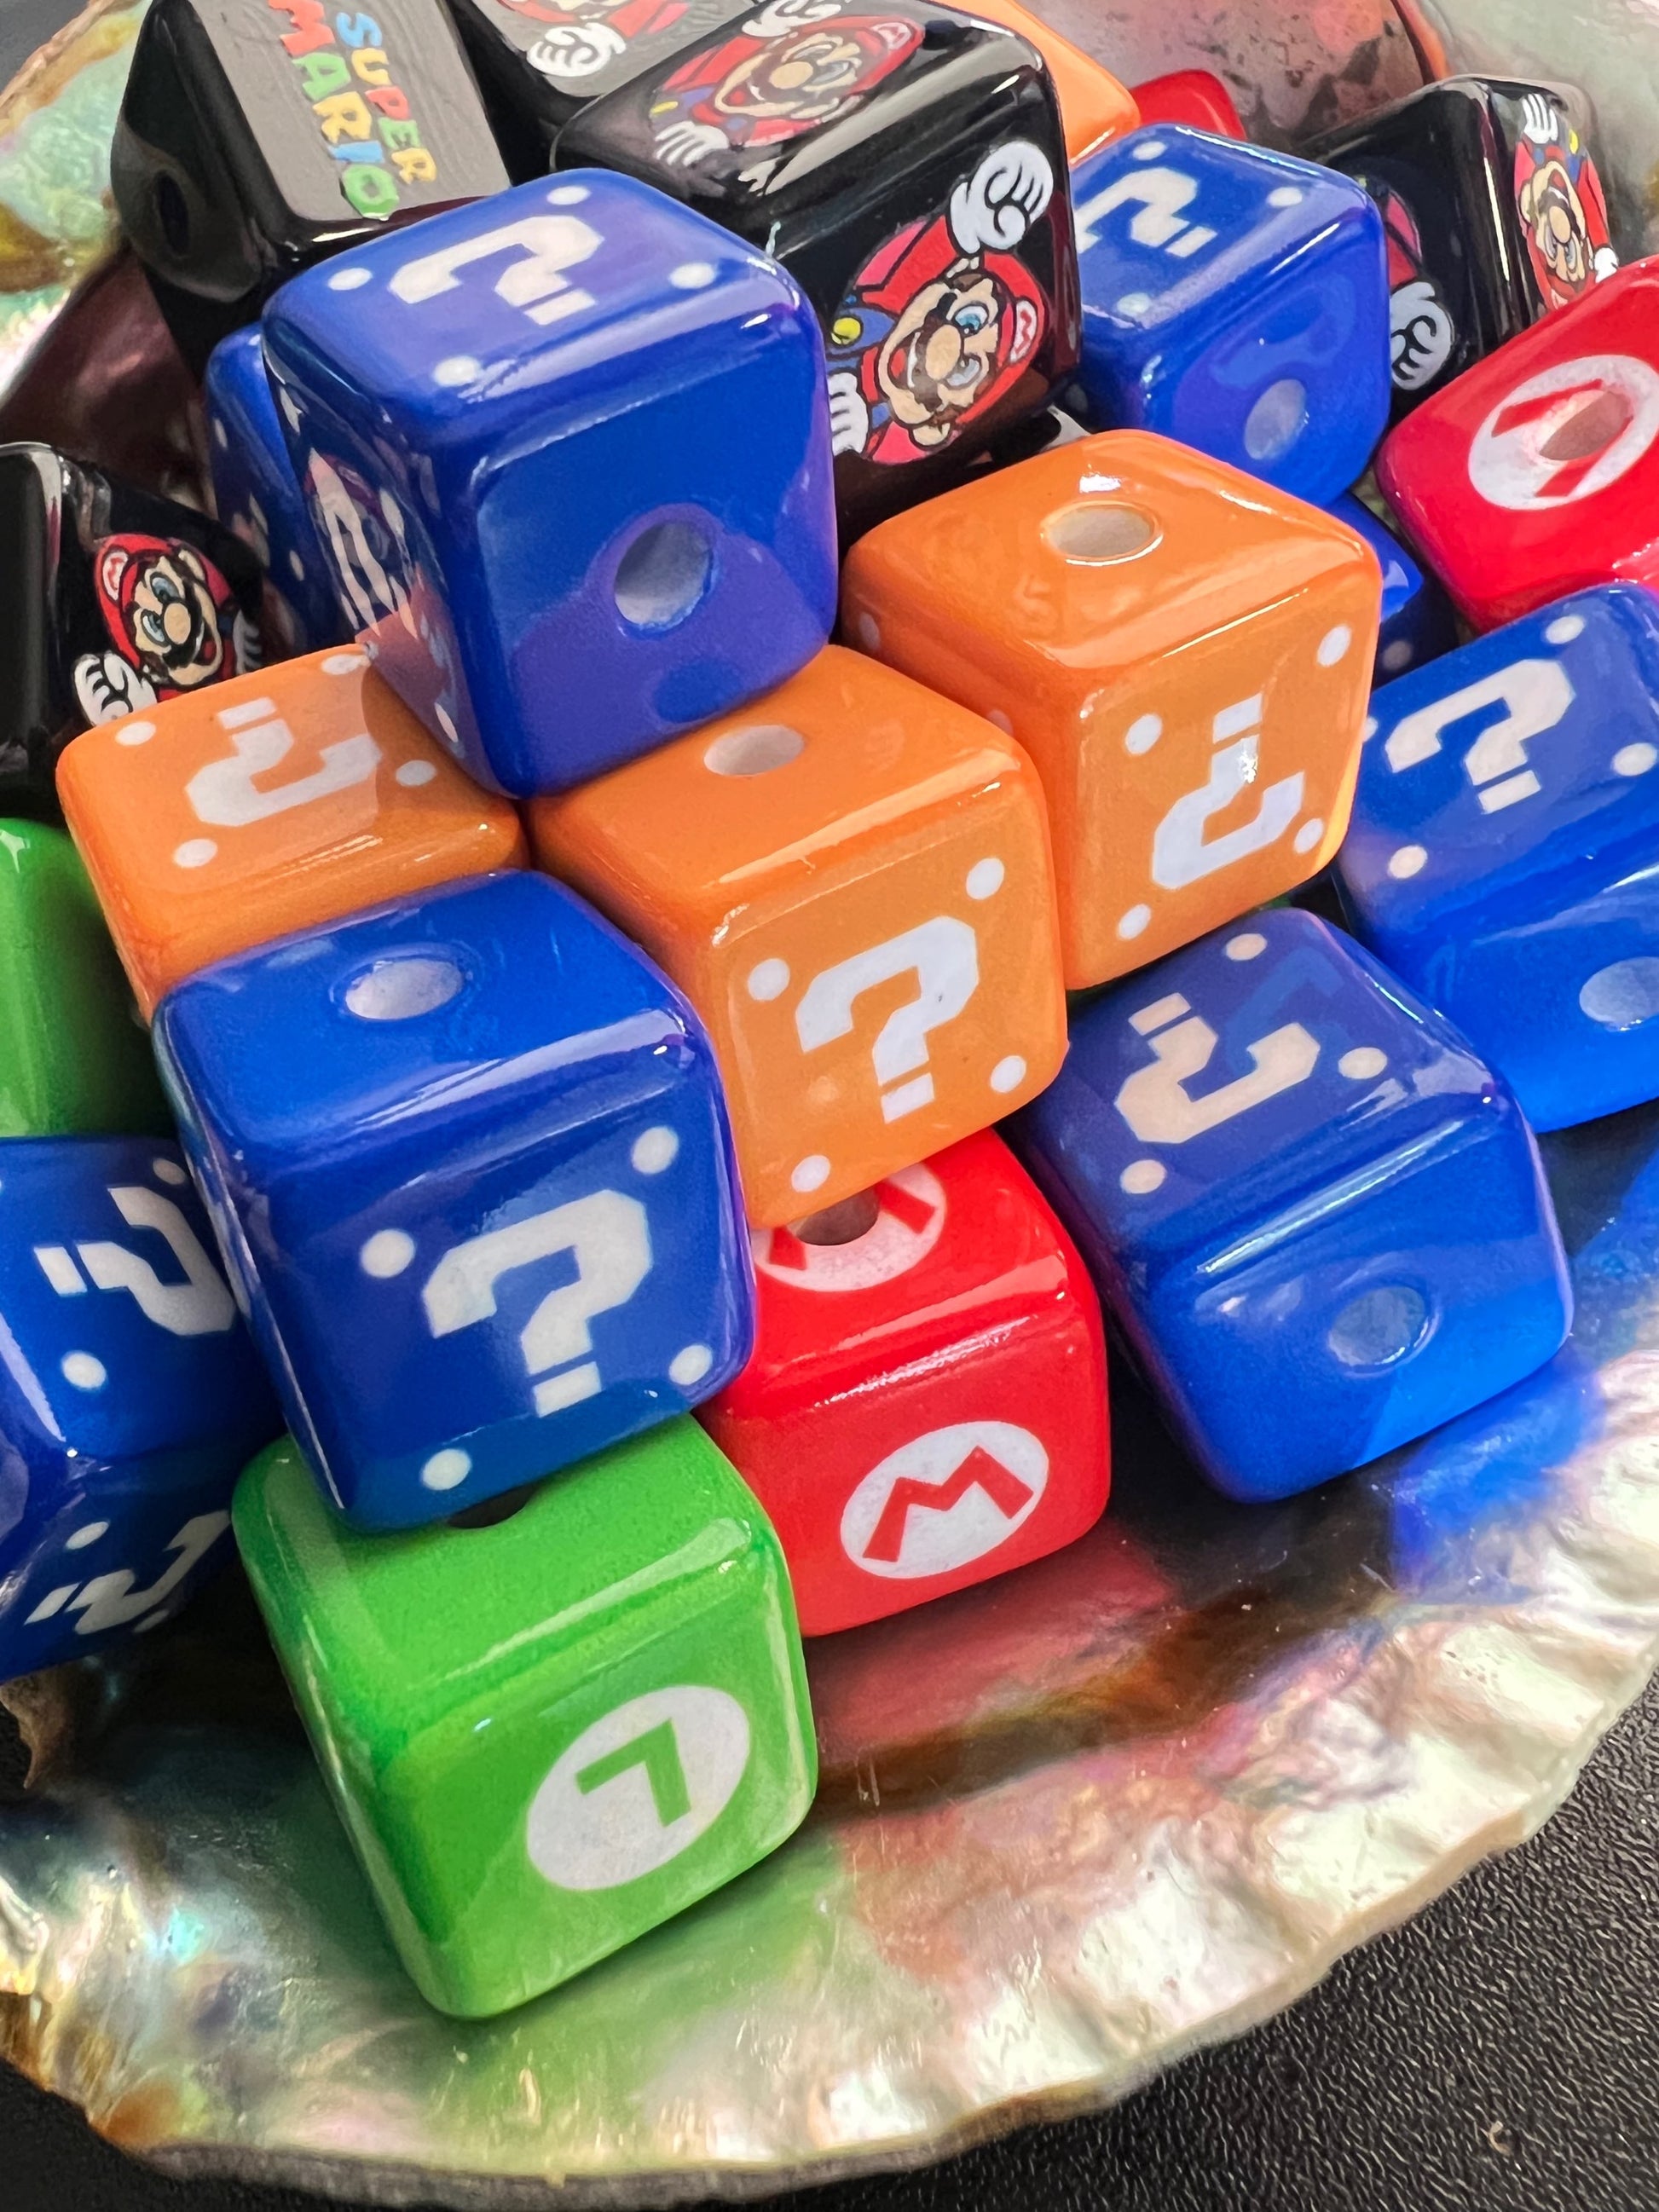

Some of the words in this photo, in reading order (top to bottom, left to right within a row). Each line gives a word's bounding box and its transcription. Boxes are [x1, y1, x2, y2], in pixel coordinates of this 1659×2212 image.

[268, 0, 399, 220] MARIO
[337, 12, 437, 184] SUPER
[389, 216, 604, 326] ?
[185, 697, 382, 826] ?
[1151, 692, 1304, 890] ?
[1385, 659, 1575, 813] ?
[796, 916, 980, 1124] ?
[1114, 993, 1321, 1144] ?
[423, 1190, 652, 1418] ?
[862, 1445, 1034, 1562] M
[575, 1717, 692, 1828] L
